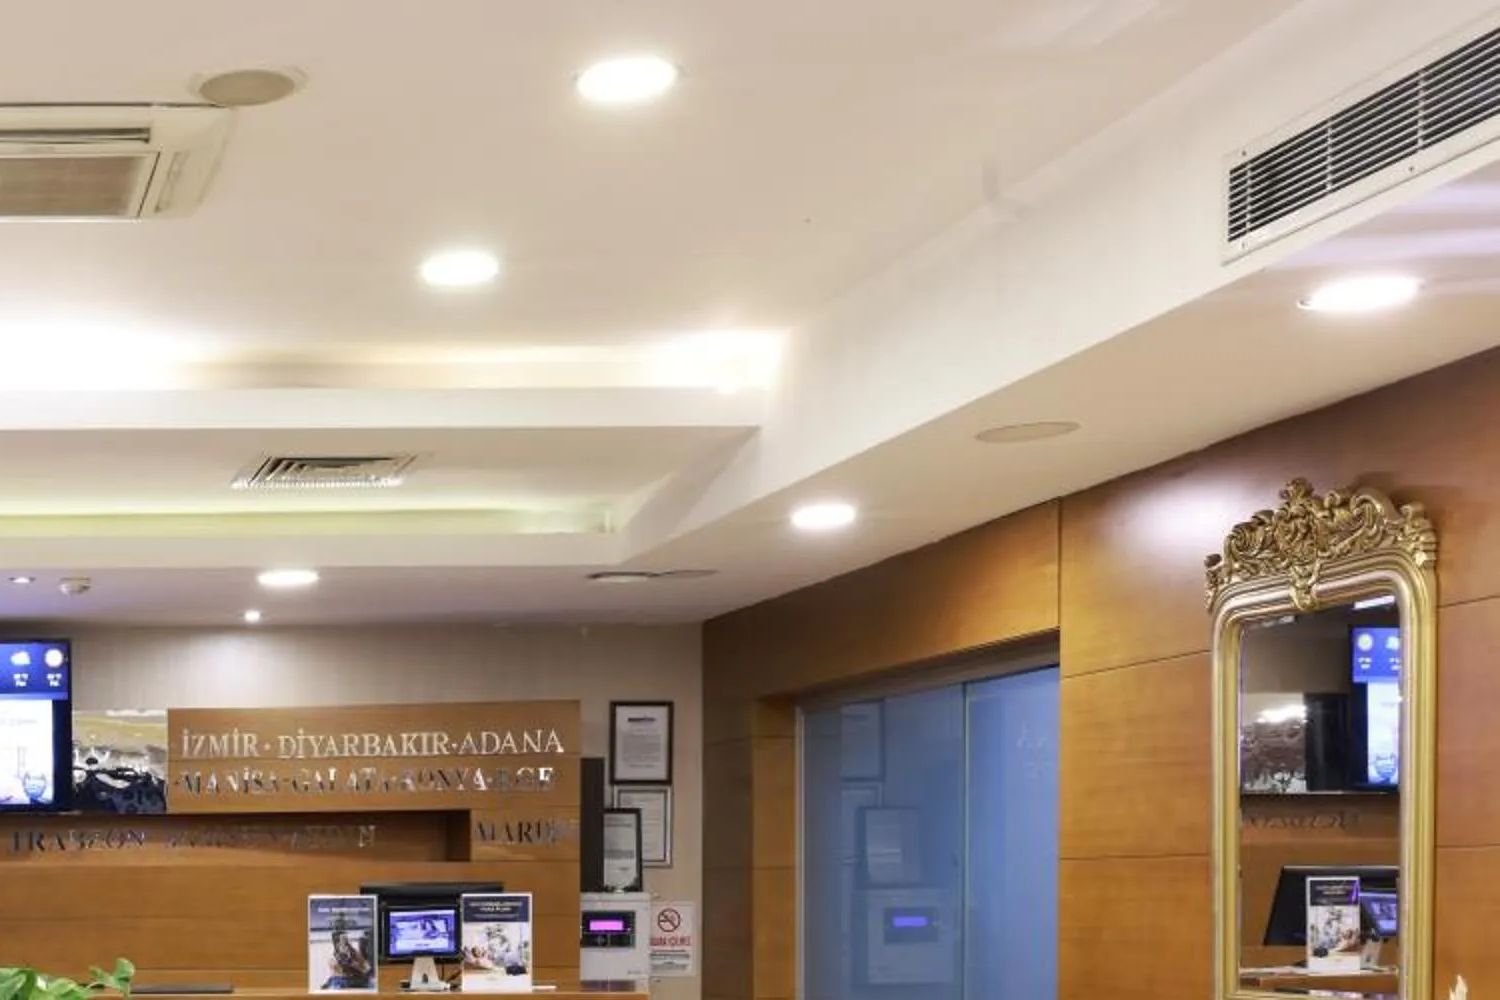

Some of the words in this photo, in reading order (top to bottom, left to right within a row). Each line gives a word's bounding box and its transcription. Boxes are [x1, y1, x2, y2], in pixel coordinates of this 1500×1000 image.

[182, 727, 260, 758] İZMİR
[276, 728, 450, 759] DİYARBAKIR
[459, 728, 565, 756] ADANA
